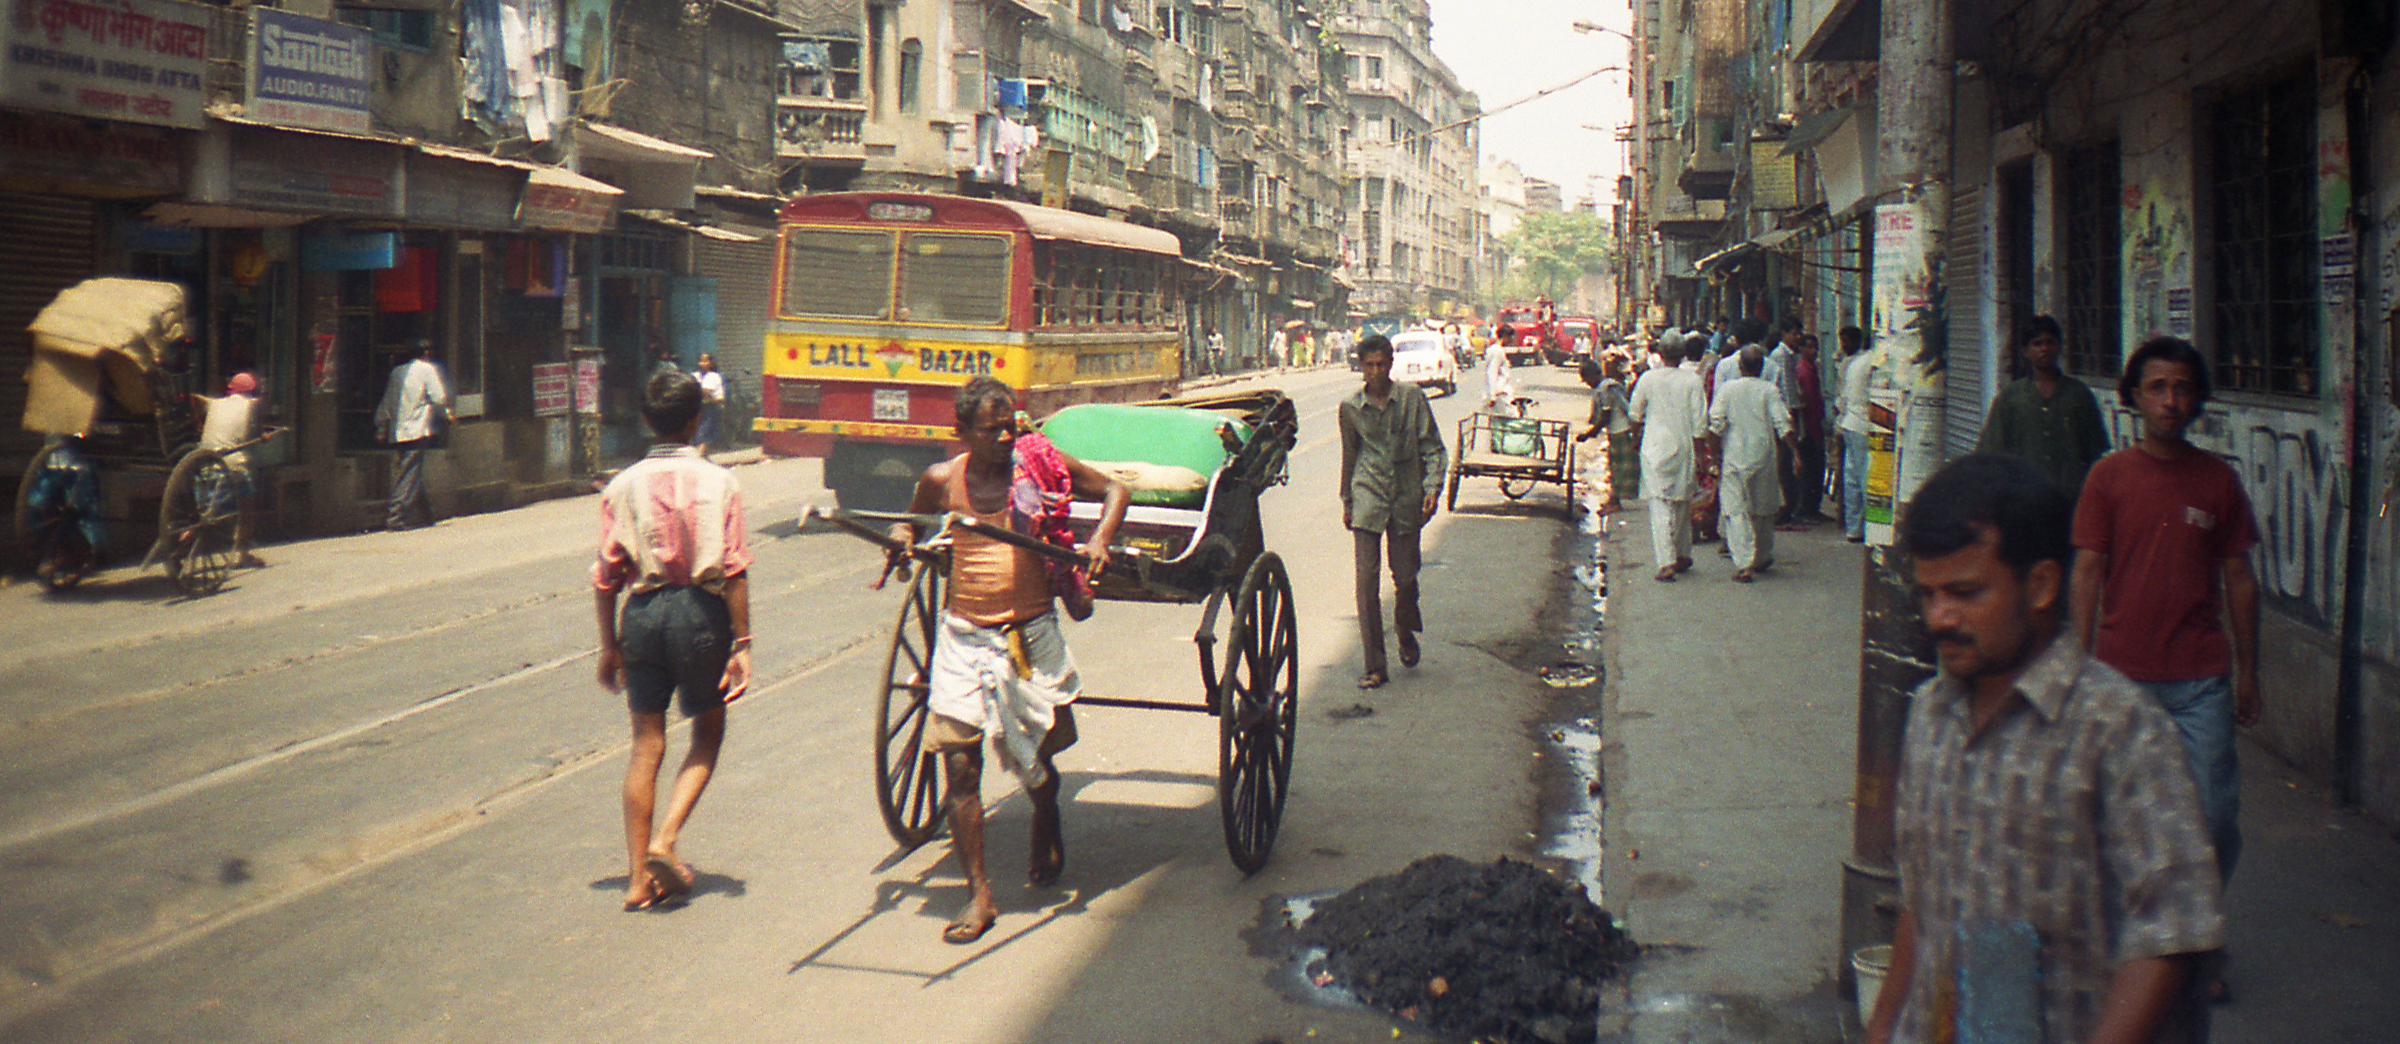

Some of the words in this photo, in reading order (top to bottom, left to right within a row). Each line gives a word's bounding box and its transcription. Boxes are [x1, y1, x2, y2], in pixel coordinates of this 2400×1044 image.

[9, 43, 97, 74] KRISHNA
[101, 58, 153, 84] BHOG
[156, 68, 201, 91] ATTA
[262, 22, 364, 80] Santosh
[808, 342, 871, 368] LALL
[919, 347, 992, 375] BAZAR
[848, 423, 919, 437] STOP
